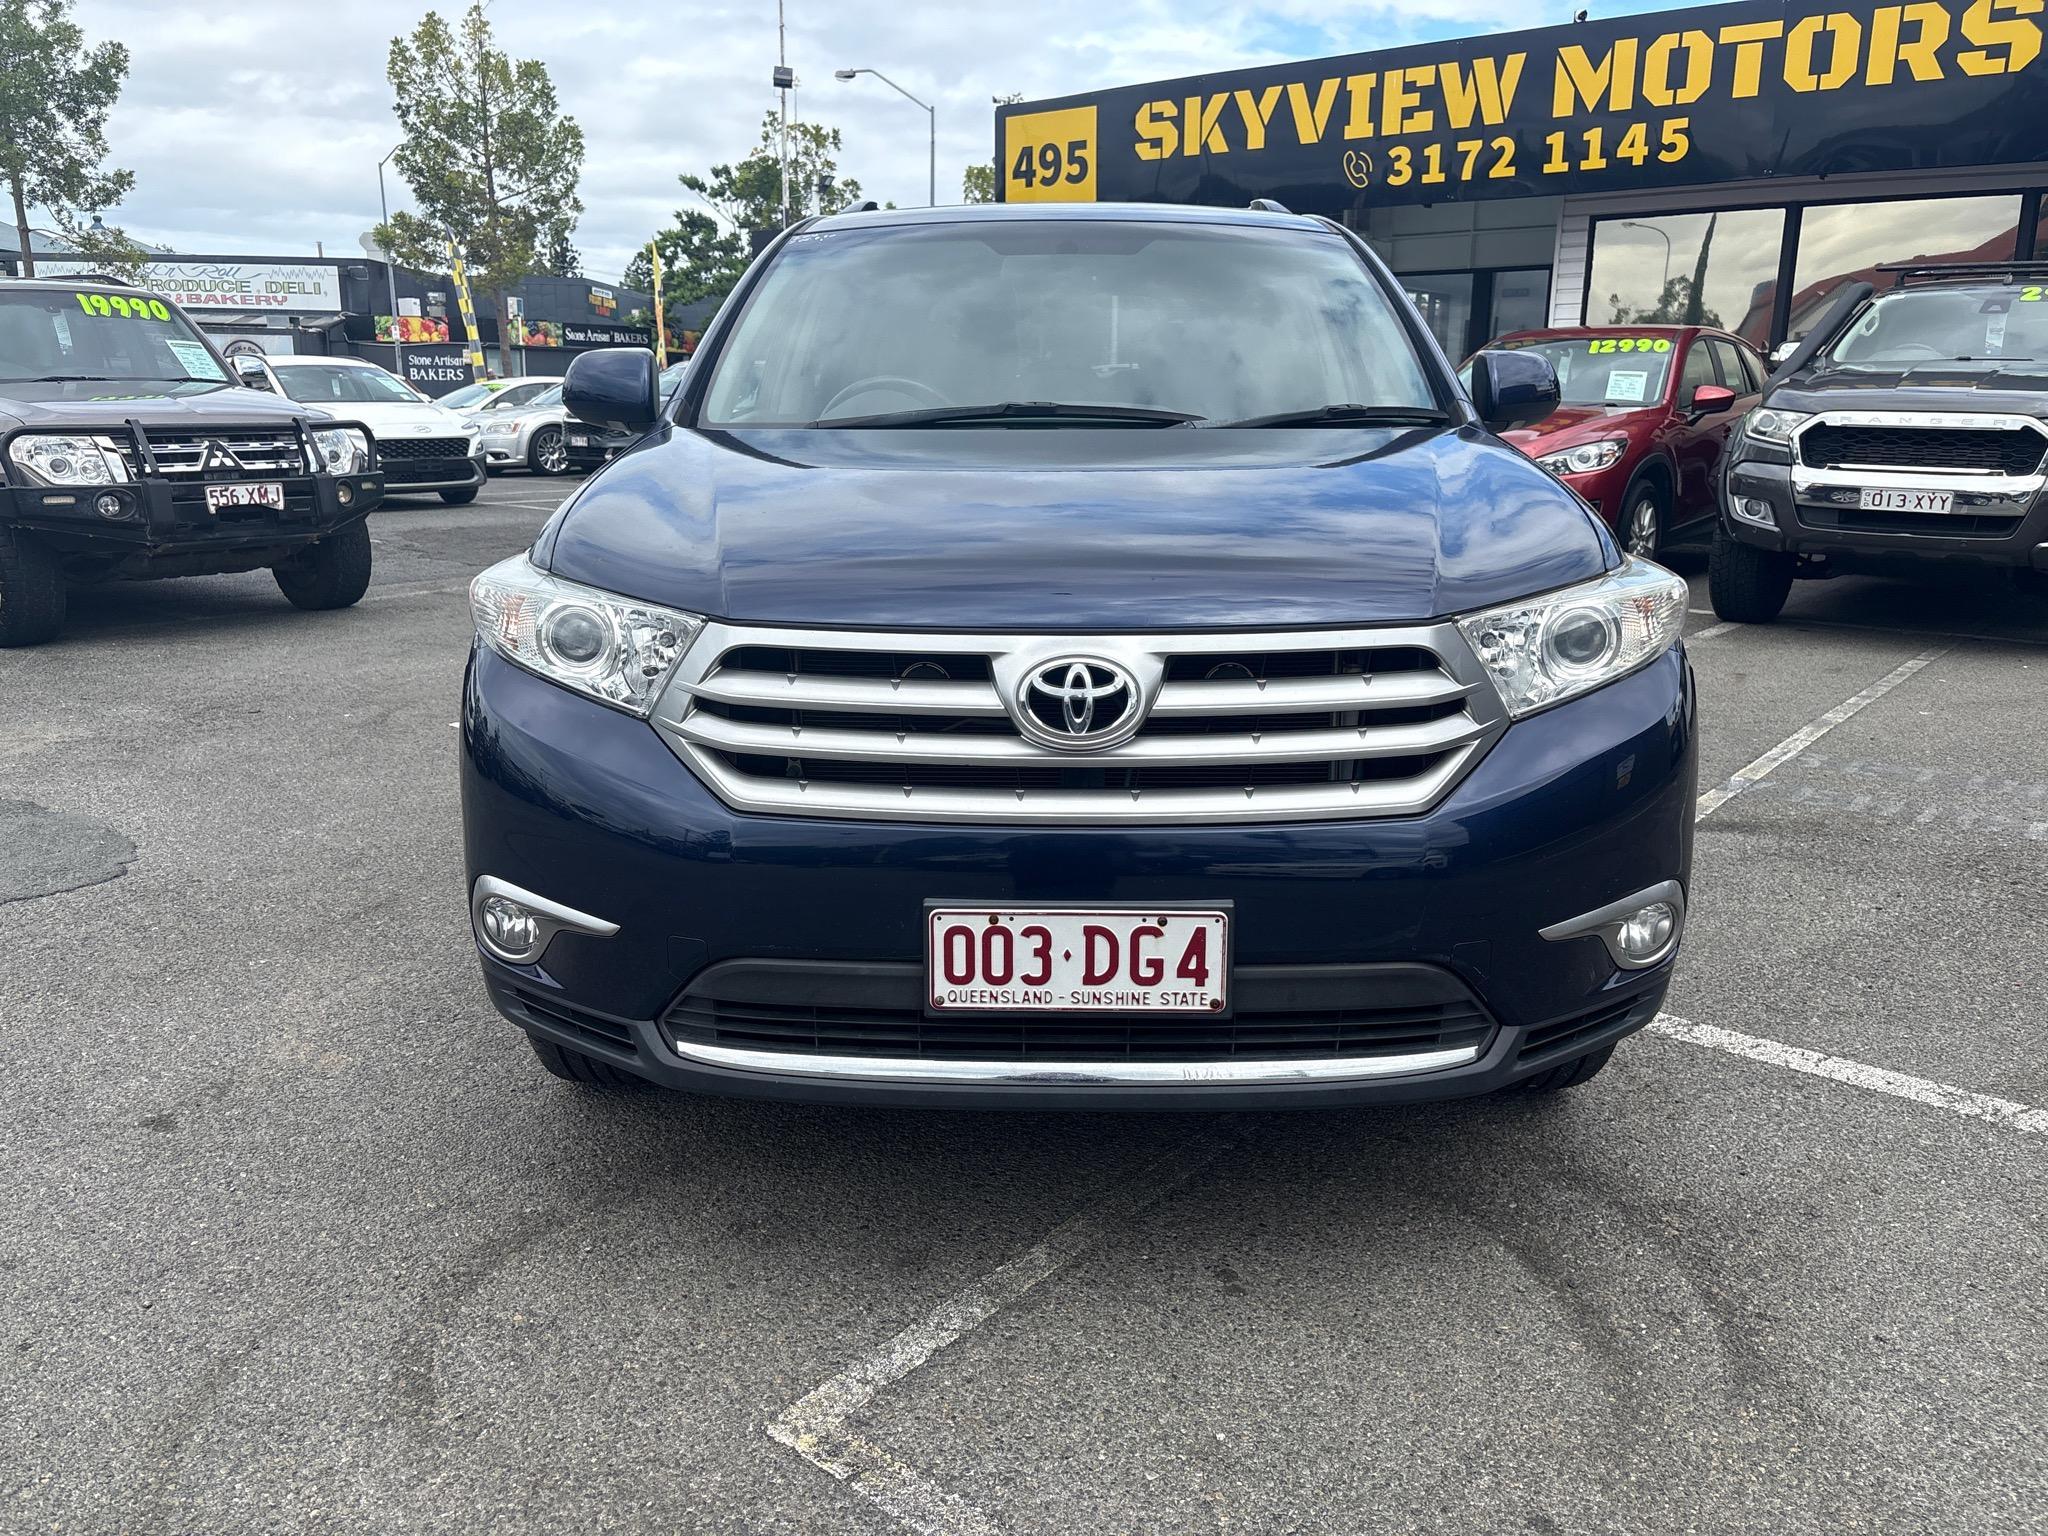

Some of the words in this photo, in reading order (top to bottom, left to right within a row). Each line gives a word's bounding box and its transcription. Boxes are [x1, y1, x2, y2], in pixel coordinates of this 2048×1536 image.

[1134, 52, 1528, 162] SKYVIEW
[1552, 0, 2044, 118] MOTORS
[1386, 136, 1517, 187] 3172
[1542, 117, 1690, 175] 1145
[1012, 139, 1090, 188] 495
[185, 264, 247, 280] Roll
[75, 292, 172, 322] 19990
[186, 293, 289, 306] BAKERY
[565, 327, 586, 341] Stone
[613, 332, 649, 345] BAKERS
[1588, 338, 1671, 354] 12990
[408, 354, 432, 366] Stone
[433, 355, 465, 367] Artisan
[410, 367, 465, 381] BAKERS
[1839, 415, 2008, 426] RANGER
[947, 989, 1053, 1005] QUEENSLAND
[1070, 990, 1151, 1006] SUNSHINE
[1159, 991, 1209, 1006] STATE
